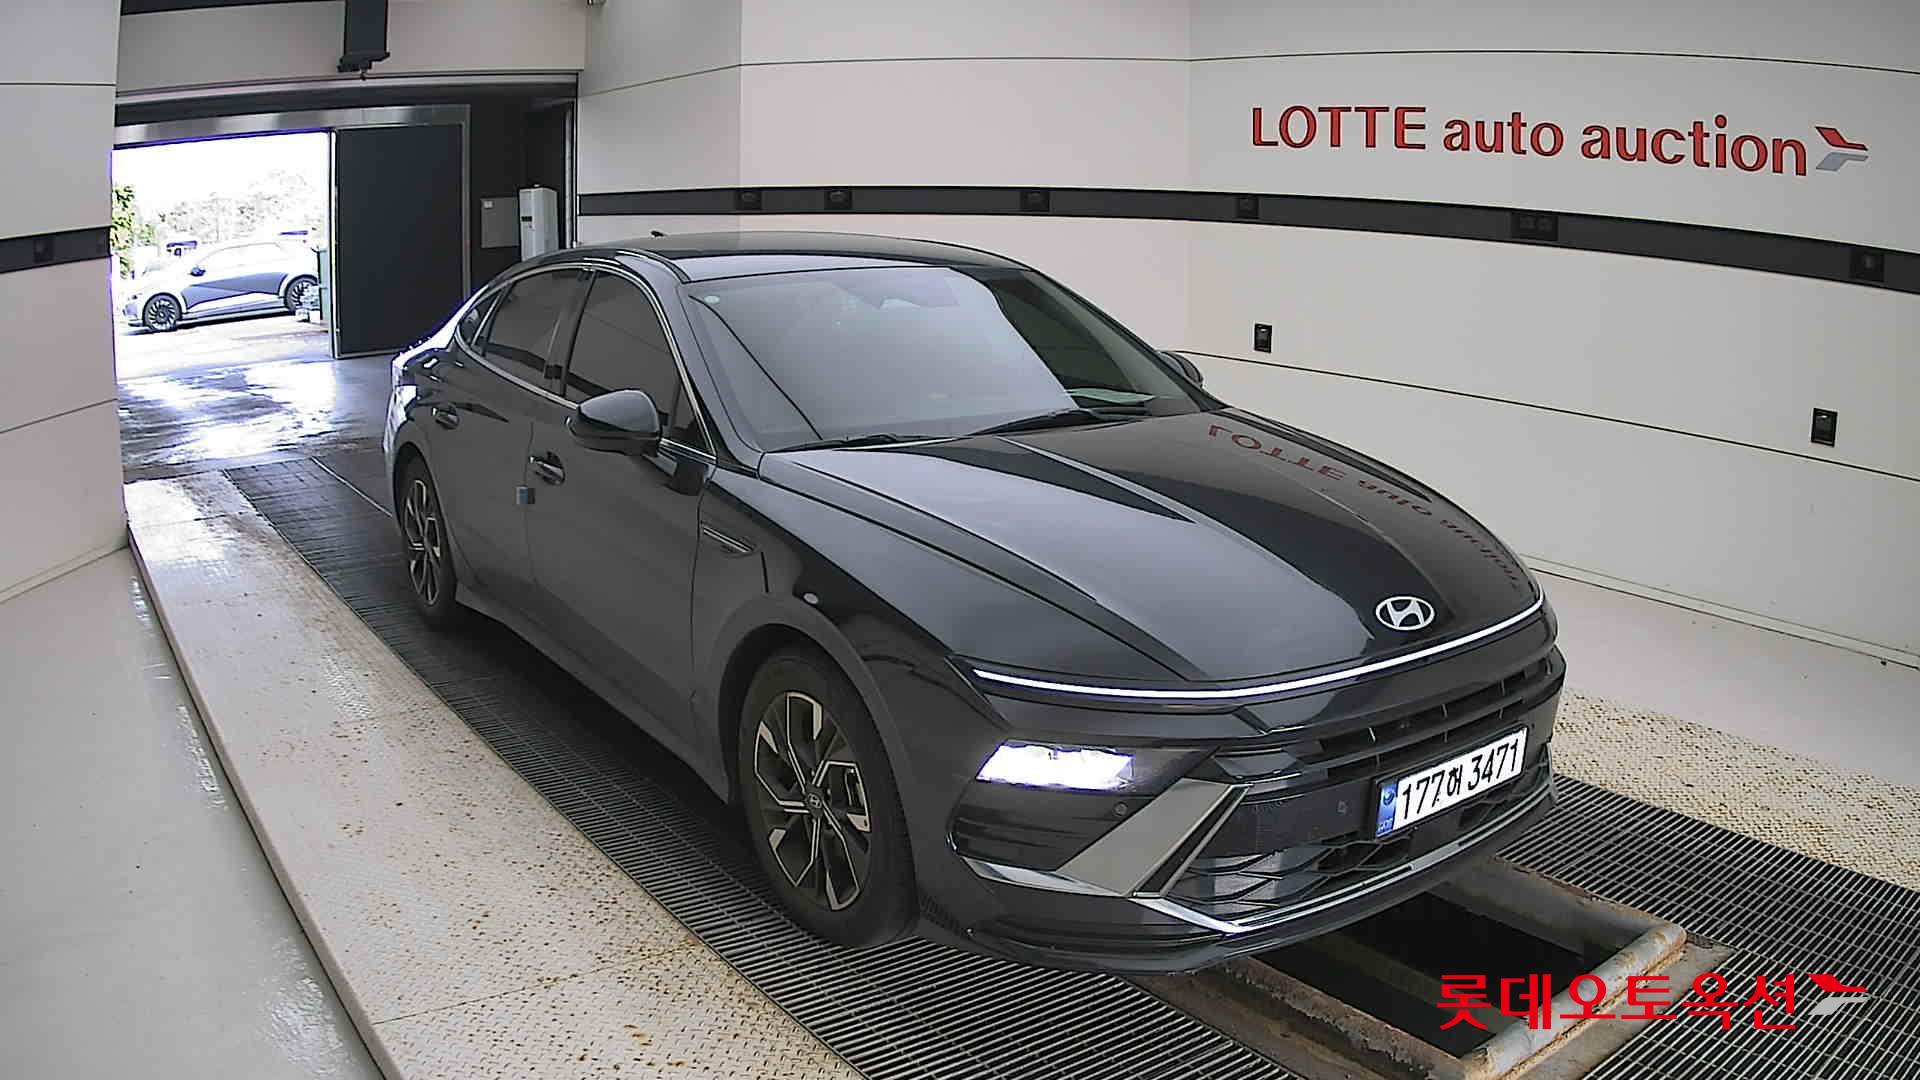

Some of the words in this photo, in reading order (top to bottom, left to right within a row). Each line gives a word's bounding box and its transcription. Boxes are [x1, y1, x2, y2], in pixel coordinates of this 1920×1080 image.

[1252, 105, 1427, 150] LOTTE
[1442, 111, 1565, 161] auto
[1581, 115, 1807, 177] auction
[1467, 738, 1519, 791] 3471
